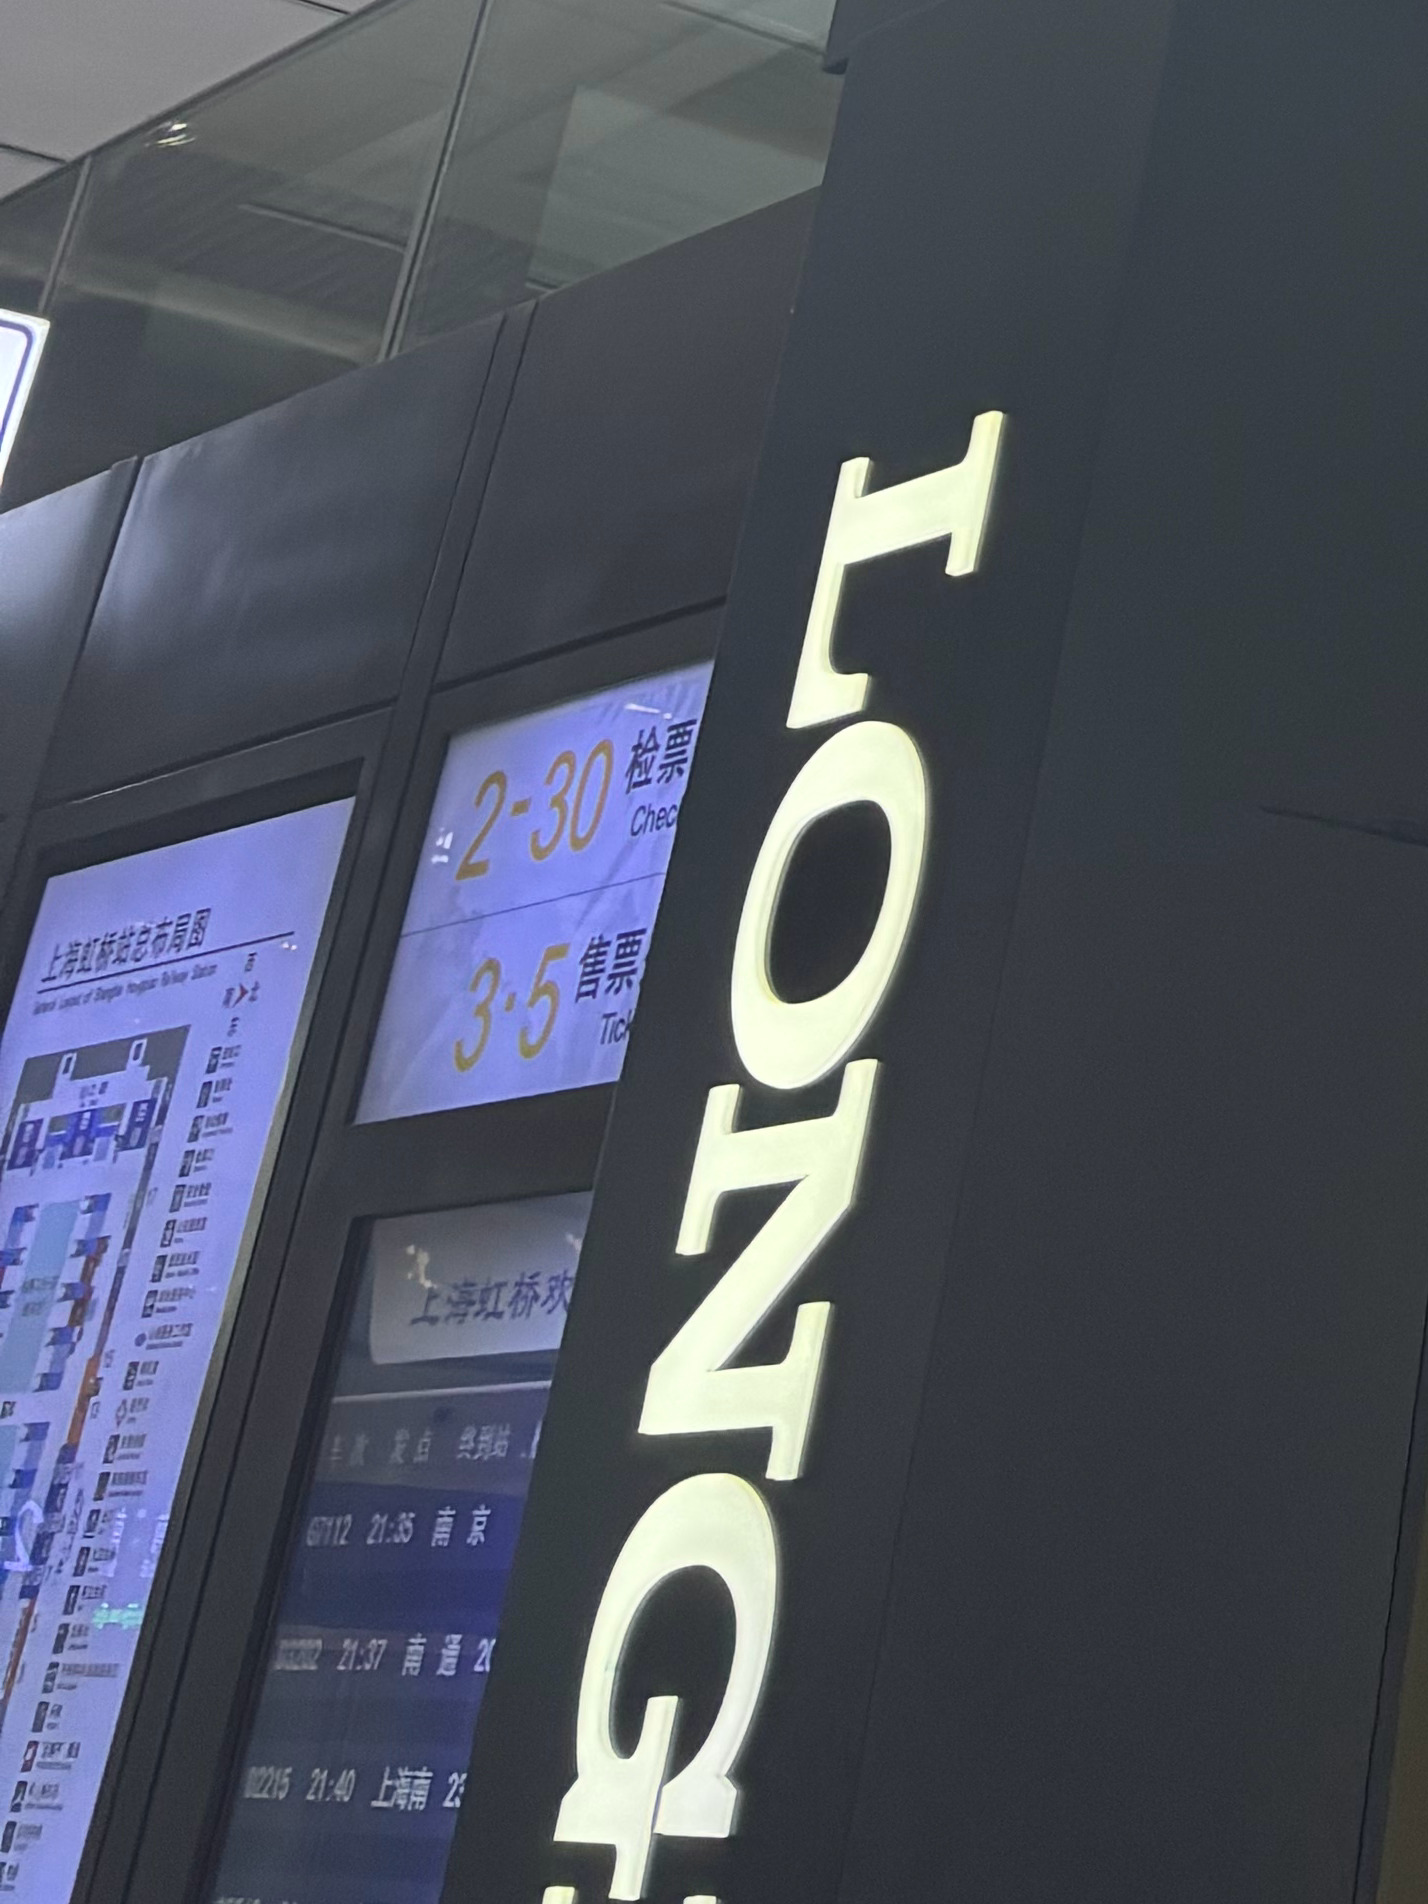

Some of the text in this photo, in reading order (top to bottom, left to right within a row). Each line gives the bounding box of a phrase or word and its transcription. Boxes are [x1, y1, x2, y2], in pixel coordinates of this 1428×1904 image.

[455, 718, 697, 881] 2-30 检票
[575, 927, 647, 1004] 售票
[541, 408, 1004, 1904] LONG
